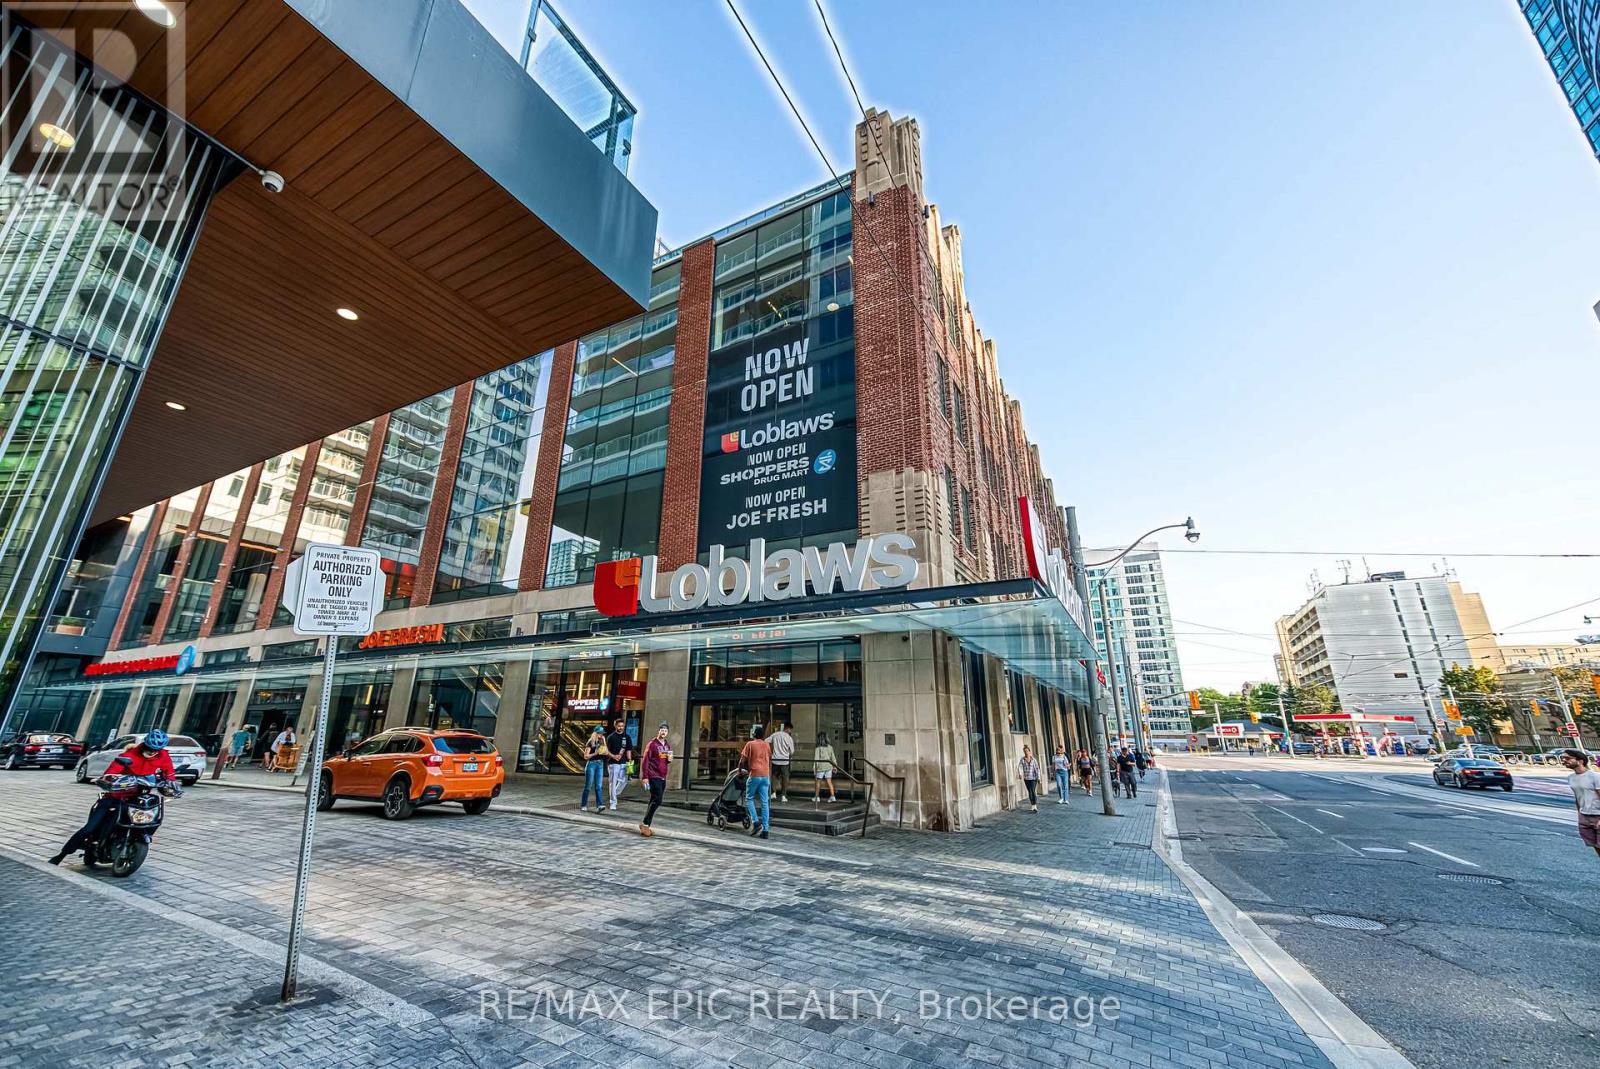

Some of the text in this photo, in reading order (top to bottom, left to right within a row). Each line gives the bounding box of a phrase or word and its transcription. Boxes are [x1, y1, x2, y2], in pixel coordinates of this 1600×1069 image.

[745, 338, 810, 381] NOW
[741, 367, 814, 412] OPEN
[741, 412, 834, 449] Loblaws
[747, 442, 807, 466] NOW OPEN
[720, 457, 810, 485] SHOPPERS
[753, 468, 810, 485] DRUG MART
[745, 486, 806, 509] NOW OPEN
[312, 560, 372, 576] AUTHORIZED
[316, 551, 371, 563] PRIVATE PROPERTY
[320, 573, 362, 587] PARKING
[640, 533, 919, 613] Loblaws
[328, 586, 352, 598] ONLY
